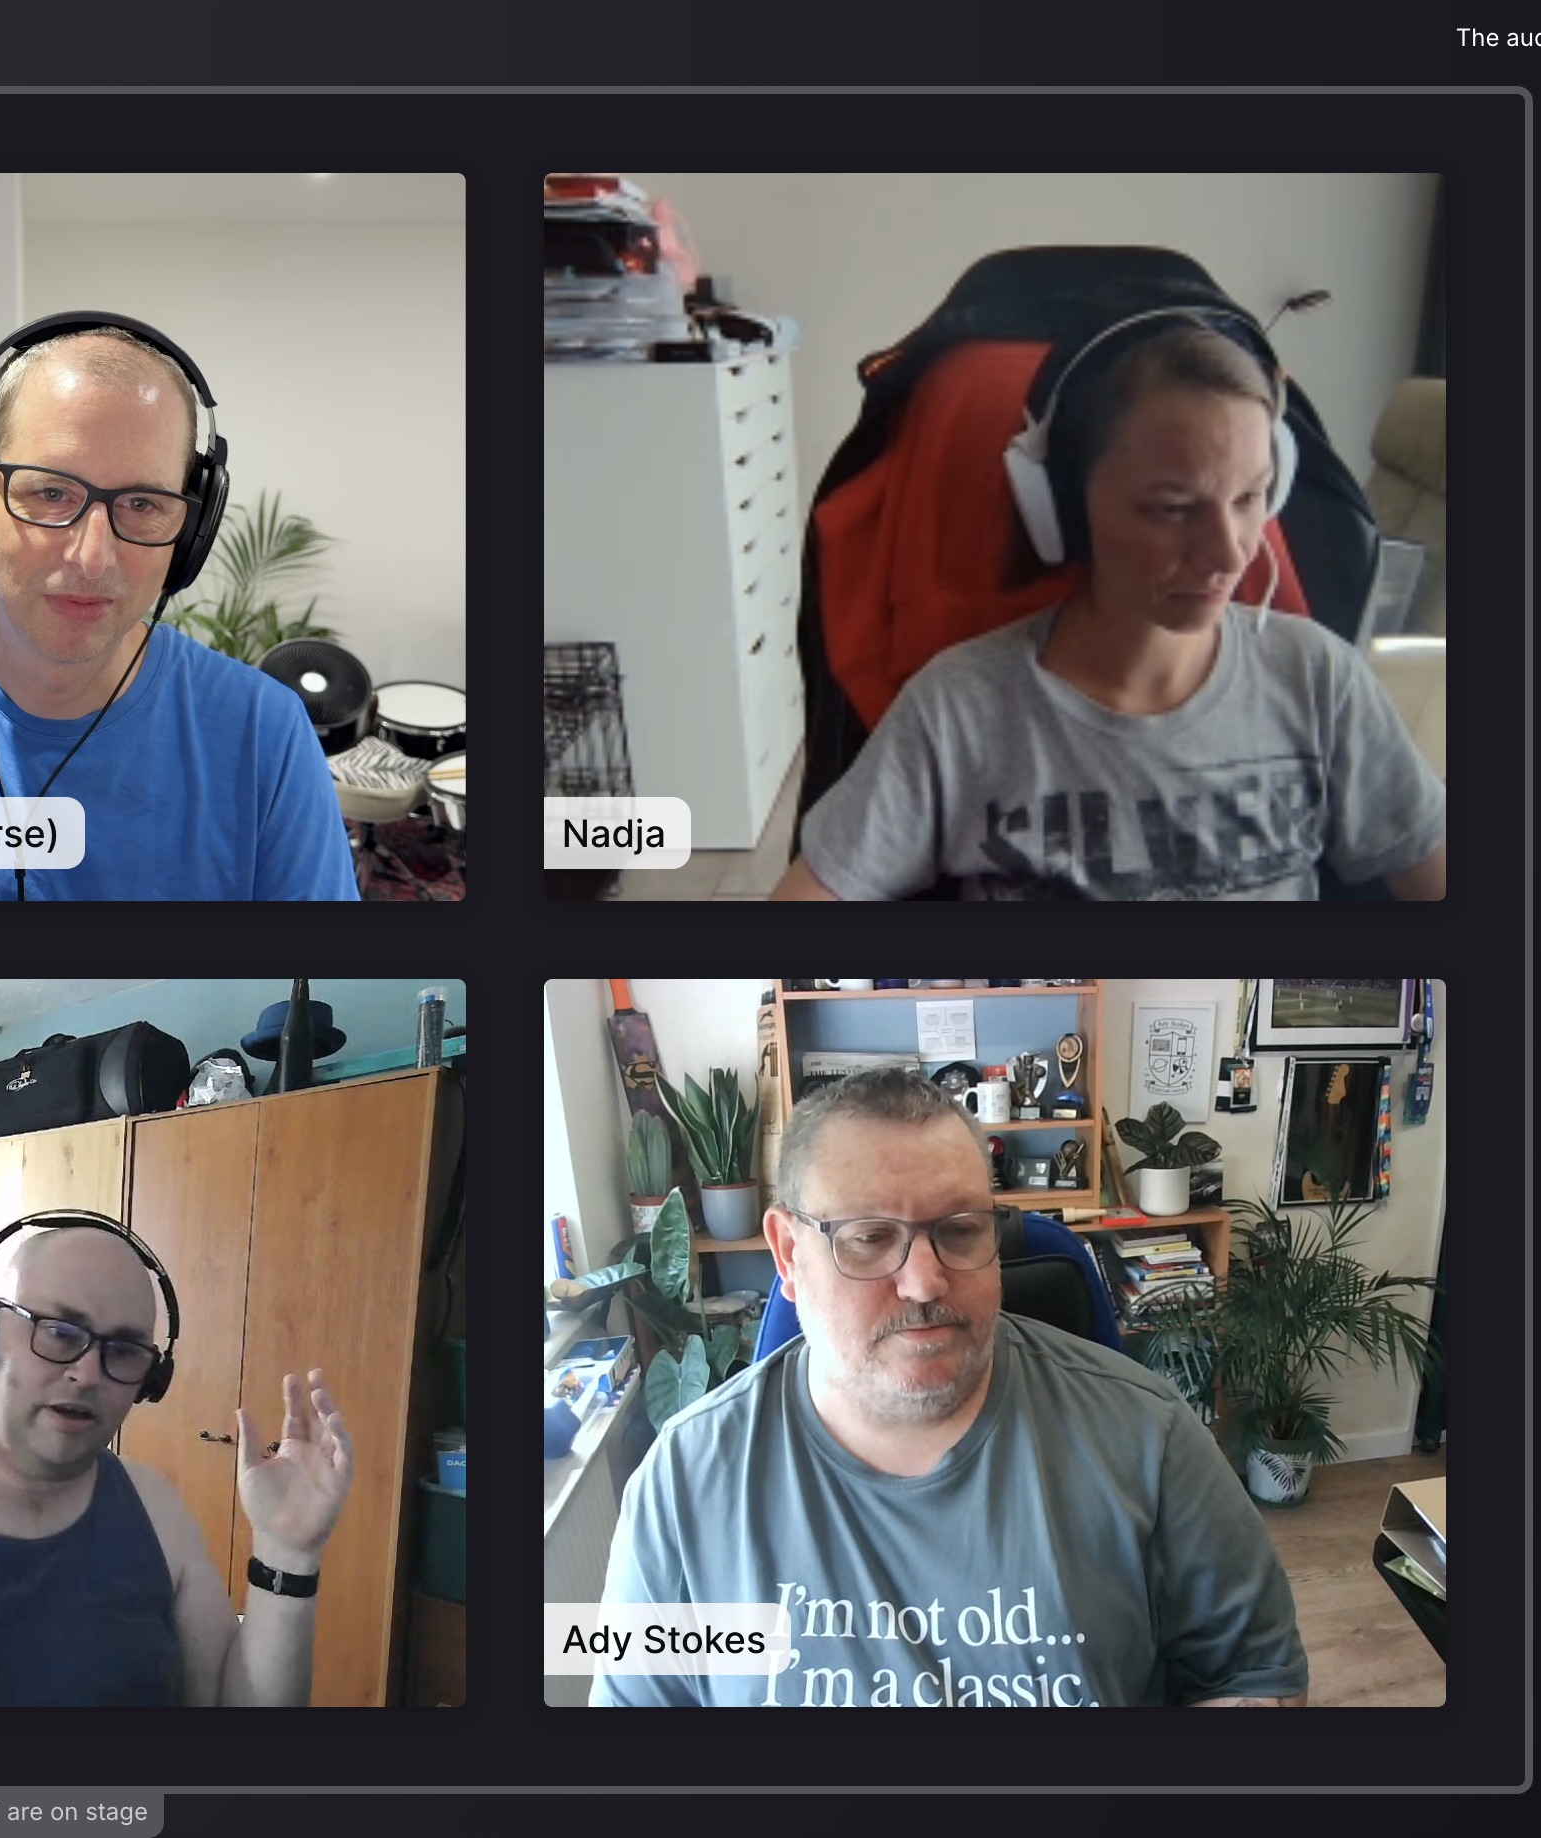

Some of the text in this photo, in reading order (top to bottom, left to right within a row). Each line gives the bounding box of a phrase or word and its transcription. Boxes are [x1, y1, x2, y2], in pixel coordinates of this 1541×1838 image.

[866, 1598, 948, 1646] not
[958, 1587, 1085, 1647] old...
[870, 1667, 902, 1707] a
